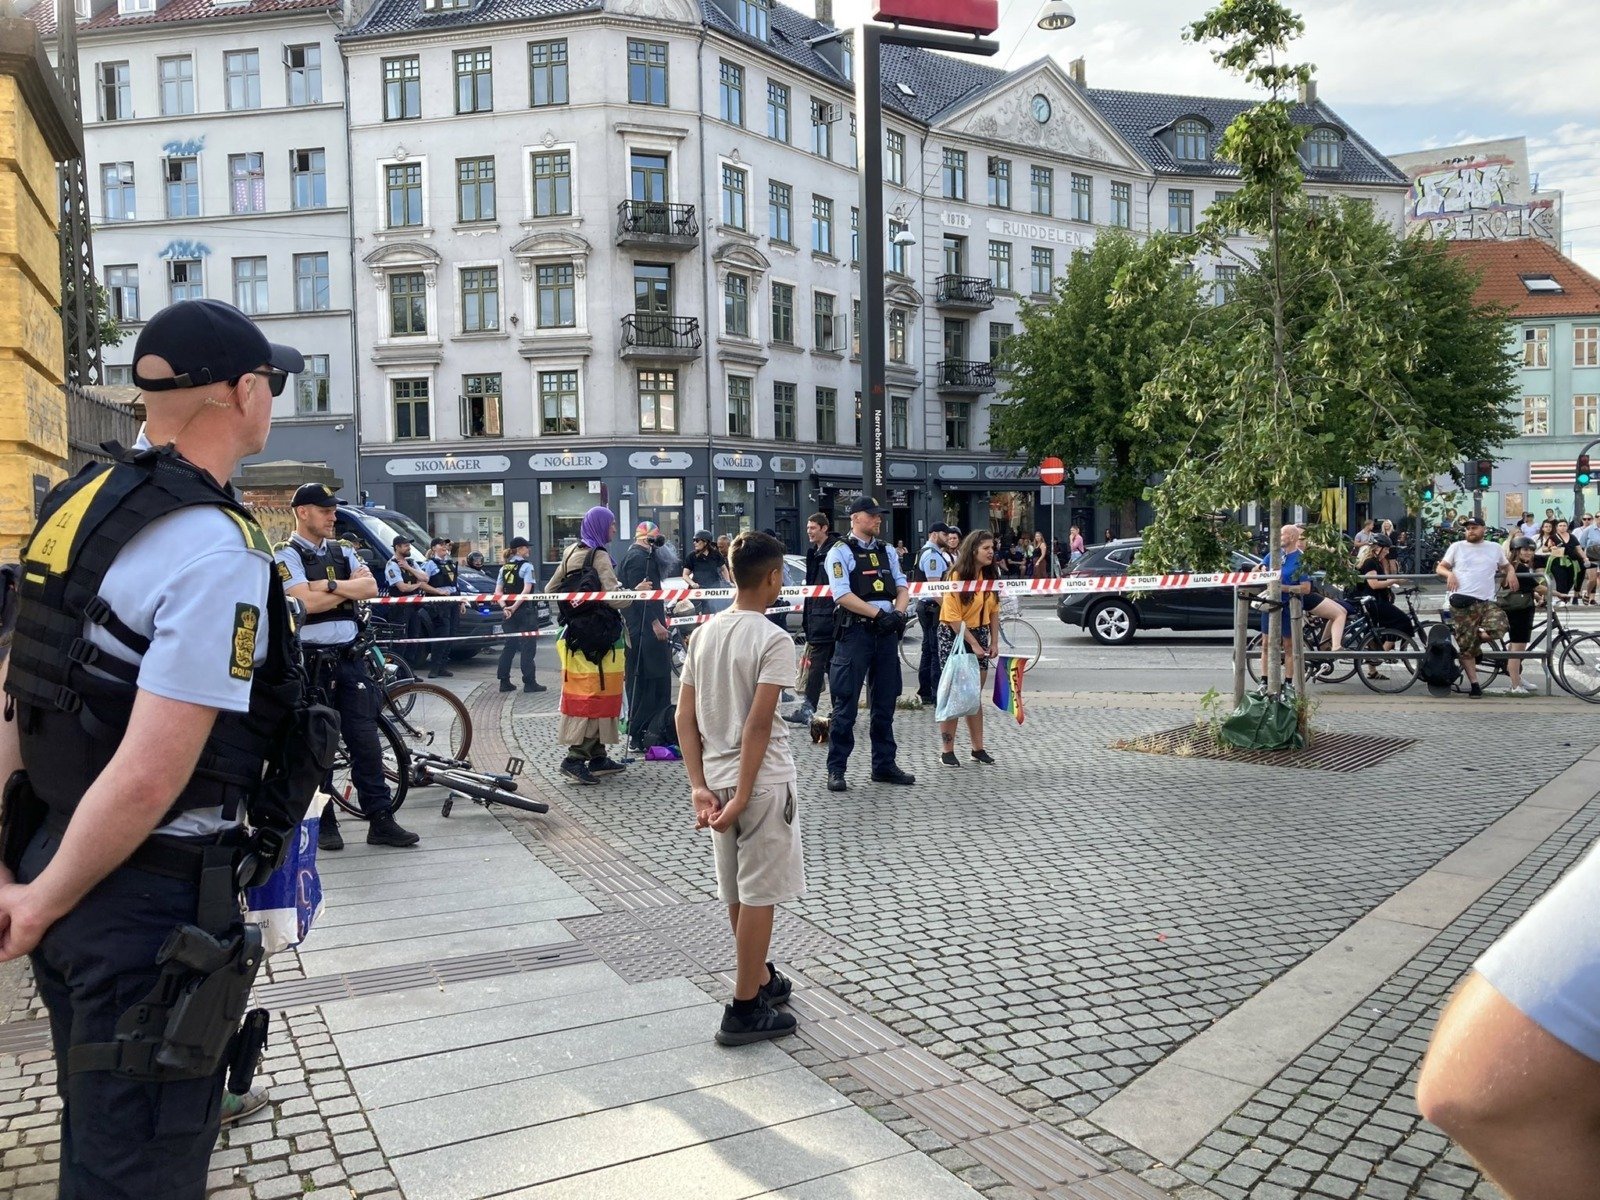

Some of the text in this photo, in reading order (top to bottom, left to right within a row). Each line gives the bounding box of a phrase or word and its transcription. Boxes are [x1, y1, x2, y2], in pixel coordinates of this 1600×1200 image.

[874, 409, 883, 486] Nørrebros Runddel
[414, 459, 482, 472] SKOMAGER
[543, 455, 593, 467] NØGLER
[722, 457, 754, 468] NØGLER
[55, 511, 73, 529] 11
